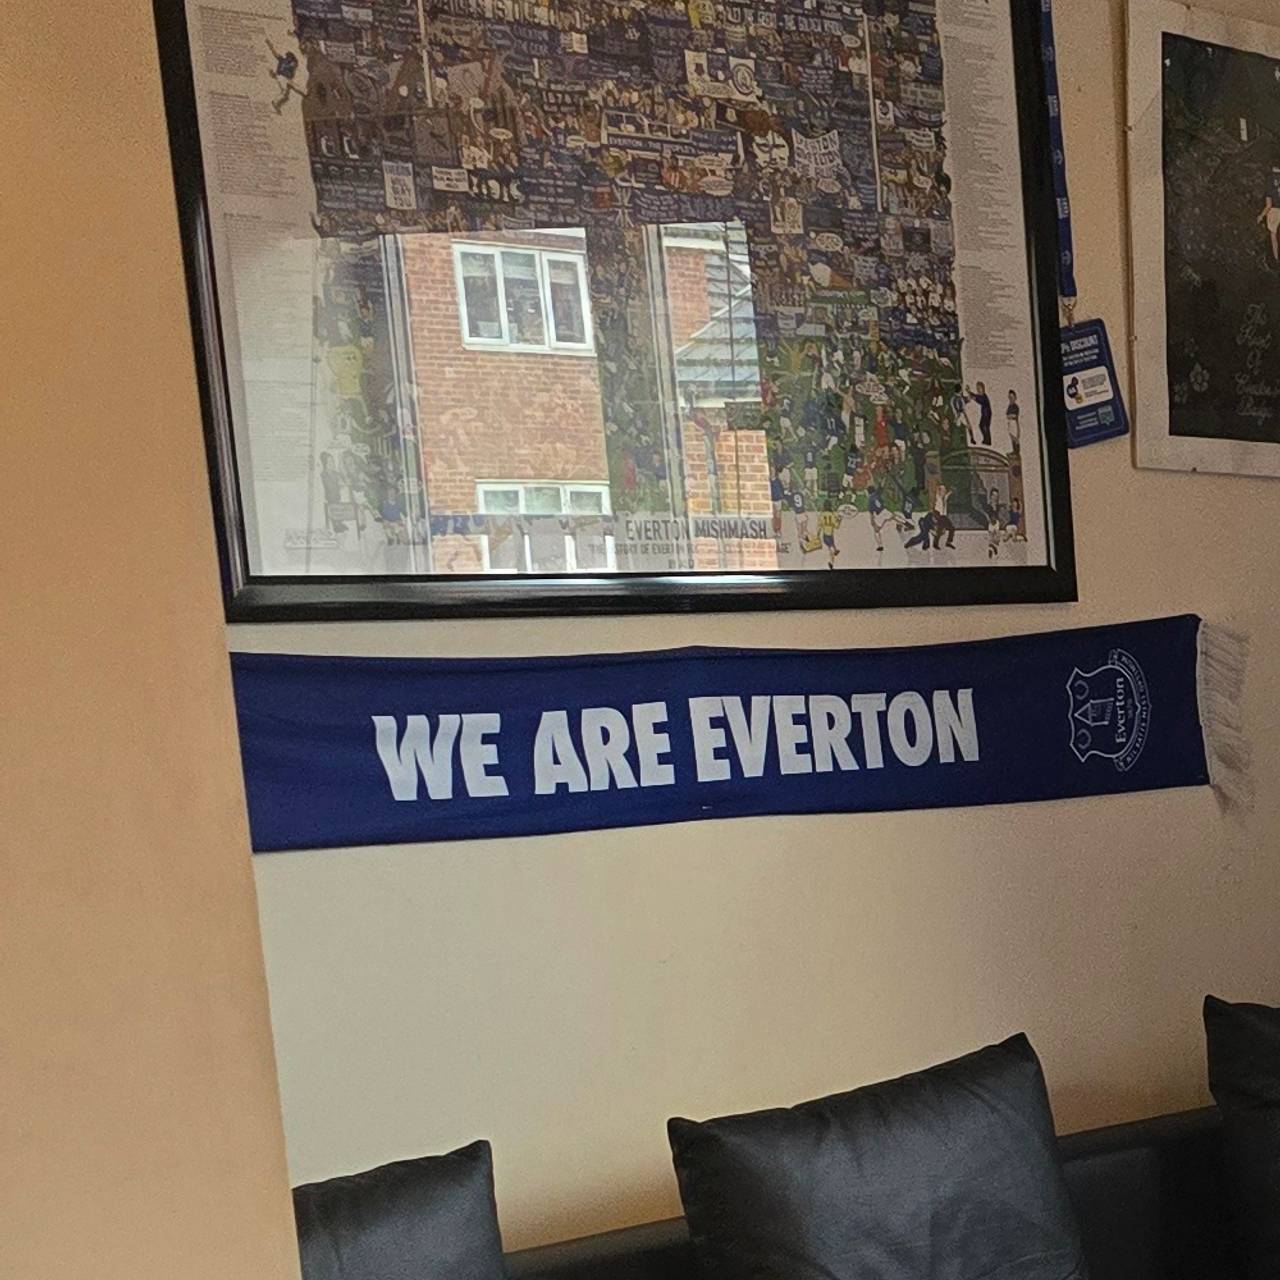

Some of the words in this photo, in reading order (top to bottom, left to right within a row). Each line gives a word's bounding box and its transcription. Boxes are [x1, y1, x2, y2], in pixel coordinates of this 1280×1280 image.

[627, 519, 690, 541] EVERTON
[694, 518, 767, 540] MISHMASH
[1115, 677, 1127, 743] Everton
[371, 711, 508, 801] WE
[533, 700, 676, 797] ARE
[688, 687, 980, 784] EVERTON
